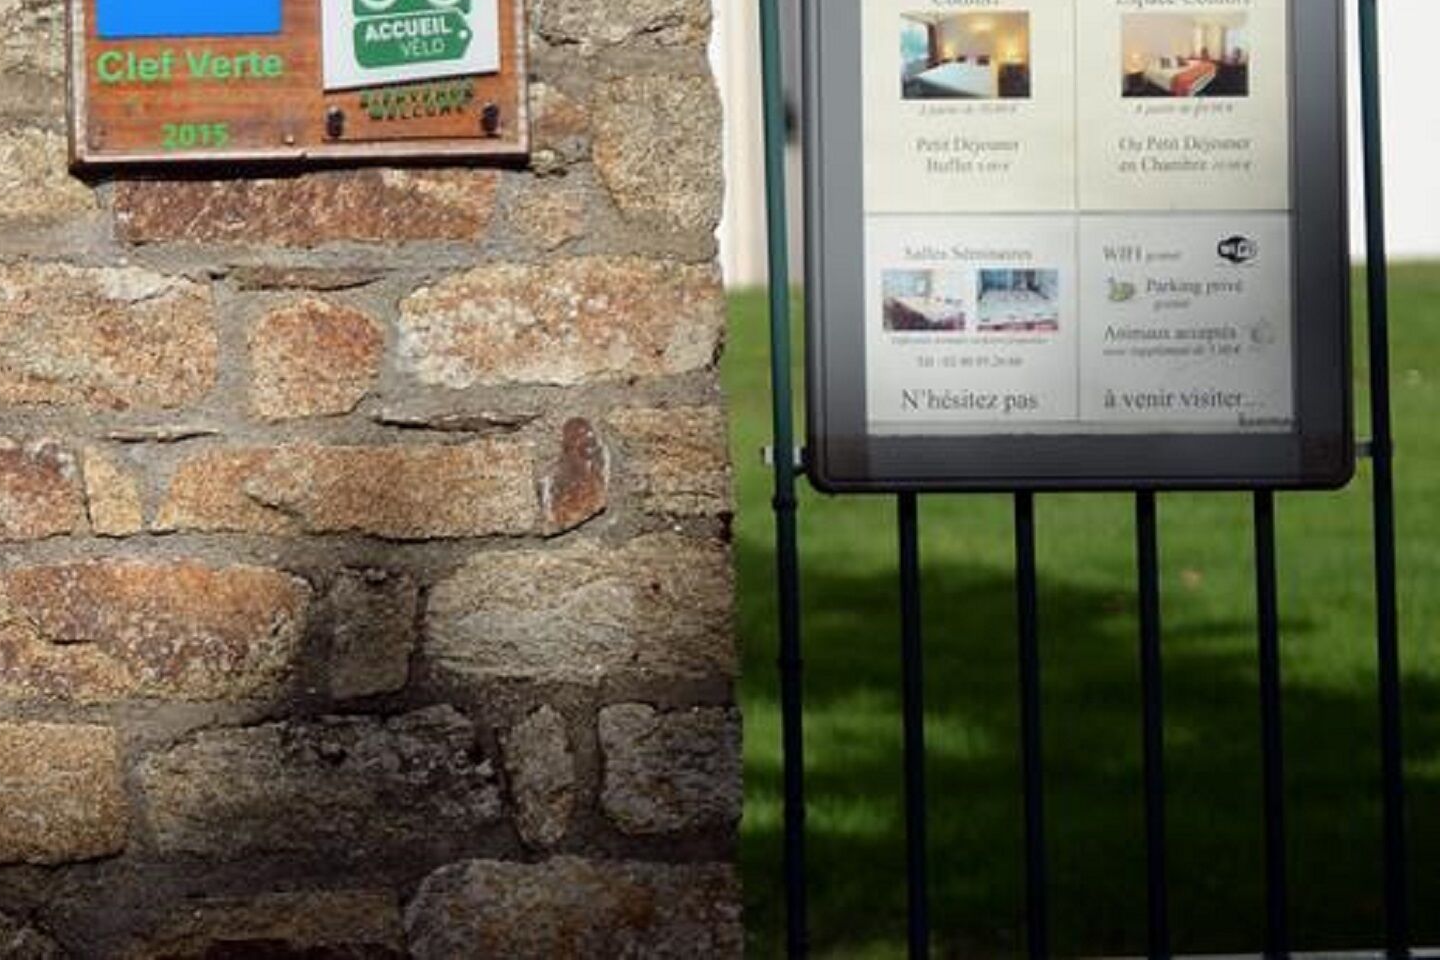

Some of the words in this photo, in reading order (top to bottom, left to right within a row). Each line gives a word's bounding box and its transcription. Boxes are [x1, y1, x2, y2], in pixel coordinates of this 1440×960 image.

[364, 14, 452, 43] ACCUEIL
[96, 49, 175, 84] Clef
[187, 48, 283, 80] Verte
[163, 123, 230, 149] 2015
[1004, 394, 1038, 414] pas
[1104, 387, 1117, 408] à
[1122, 390, 1174, 409] venir
